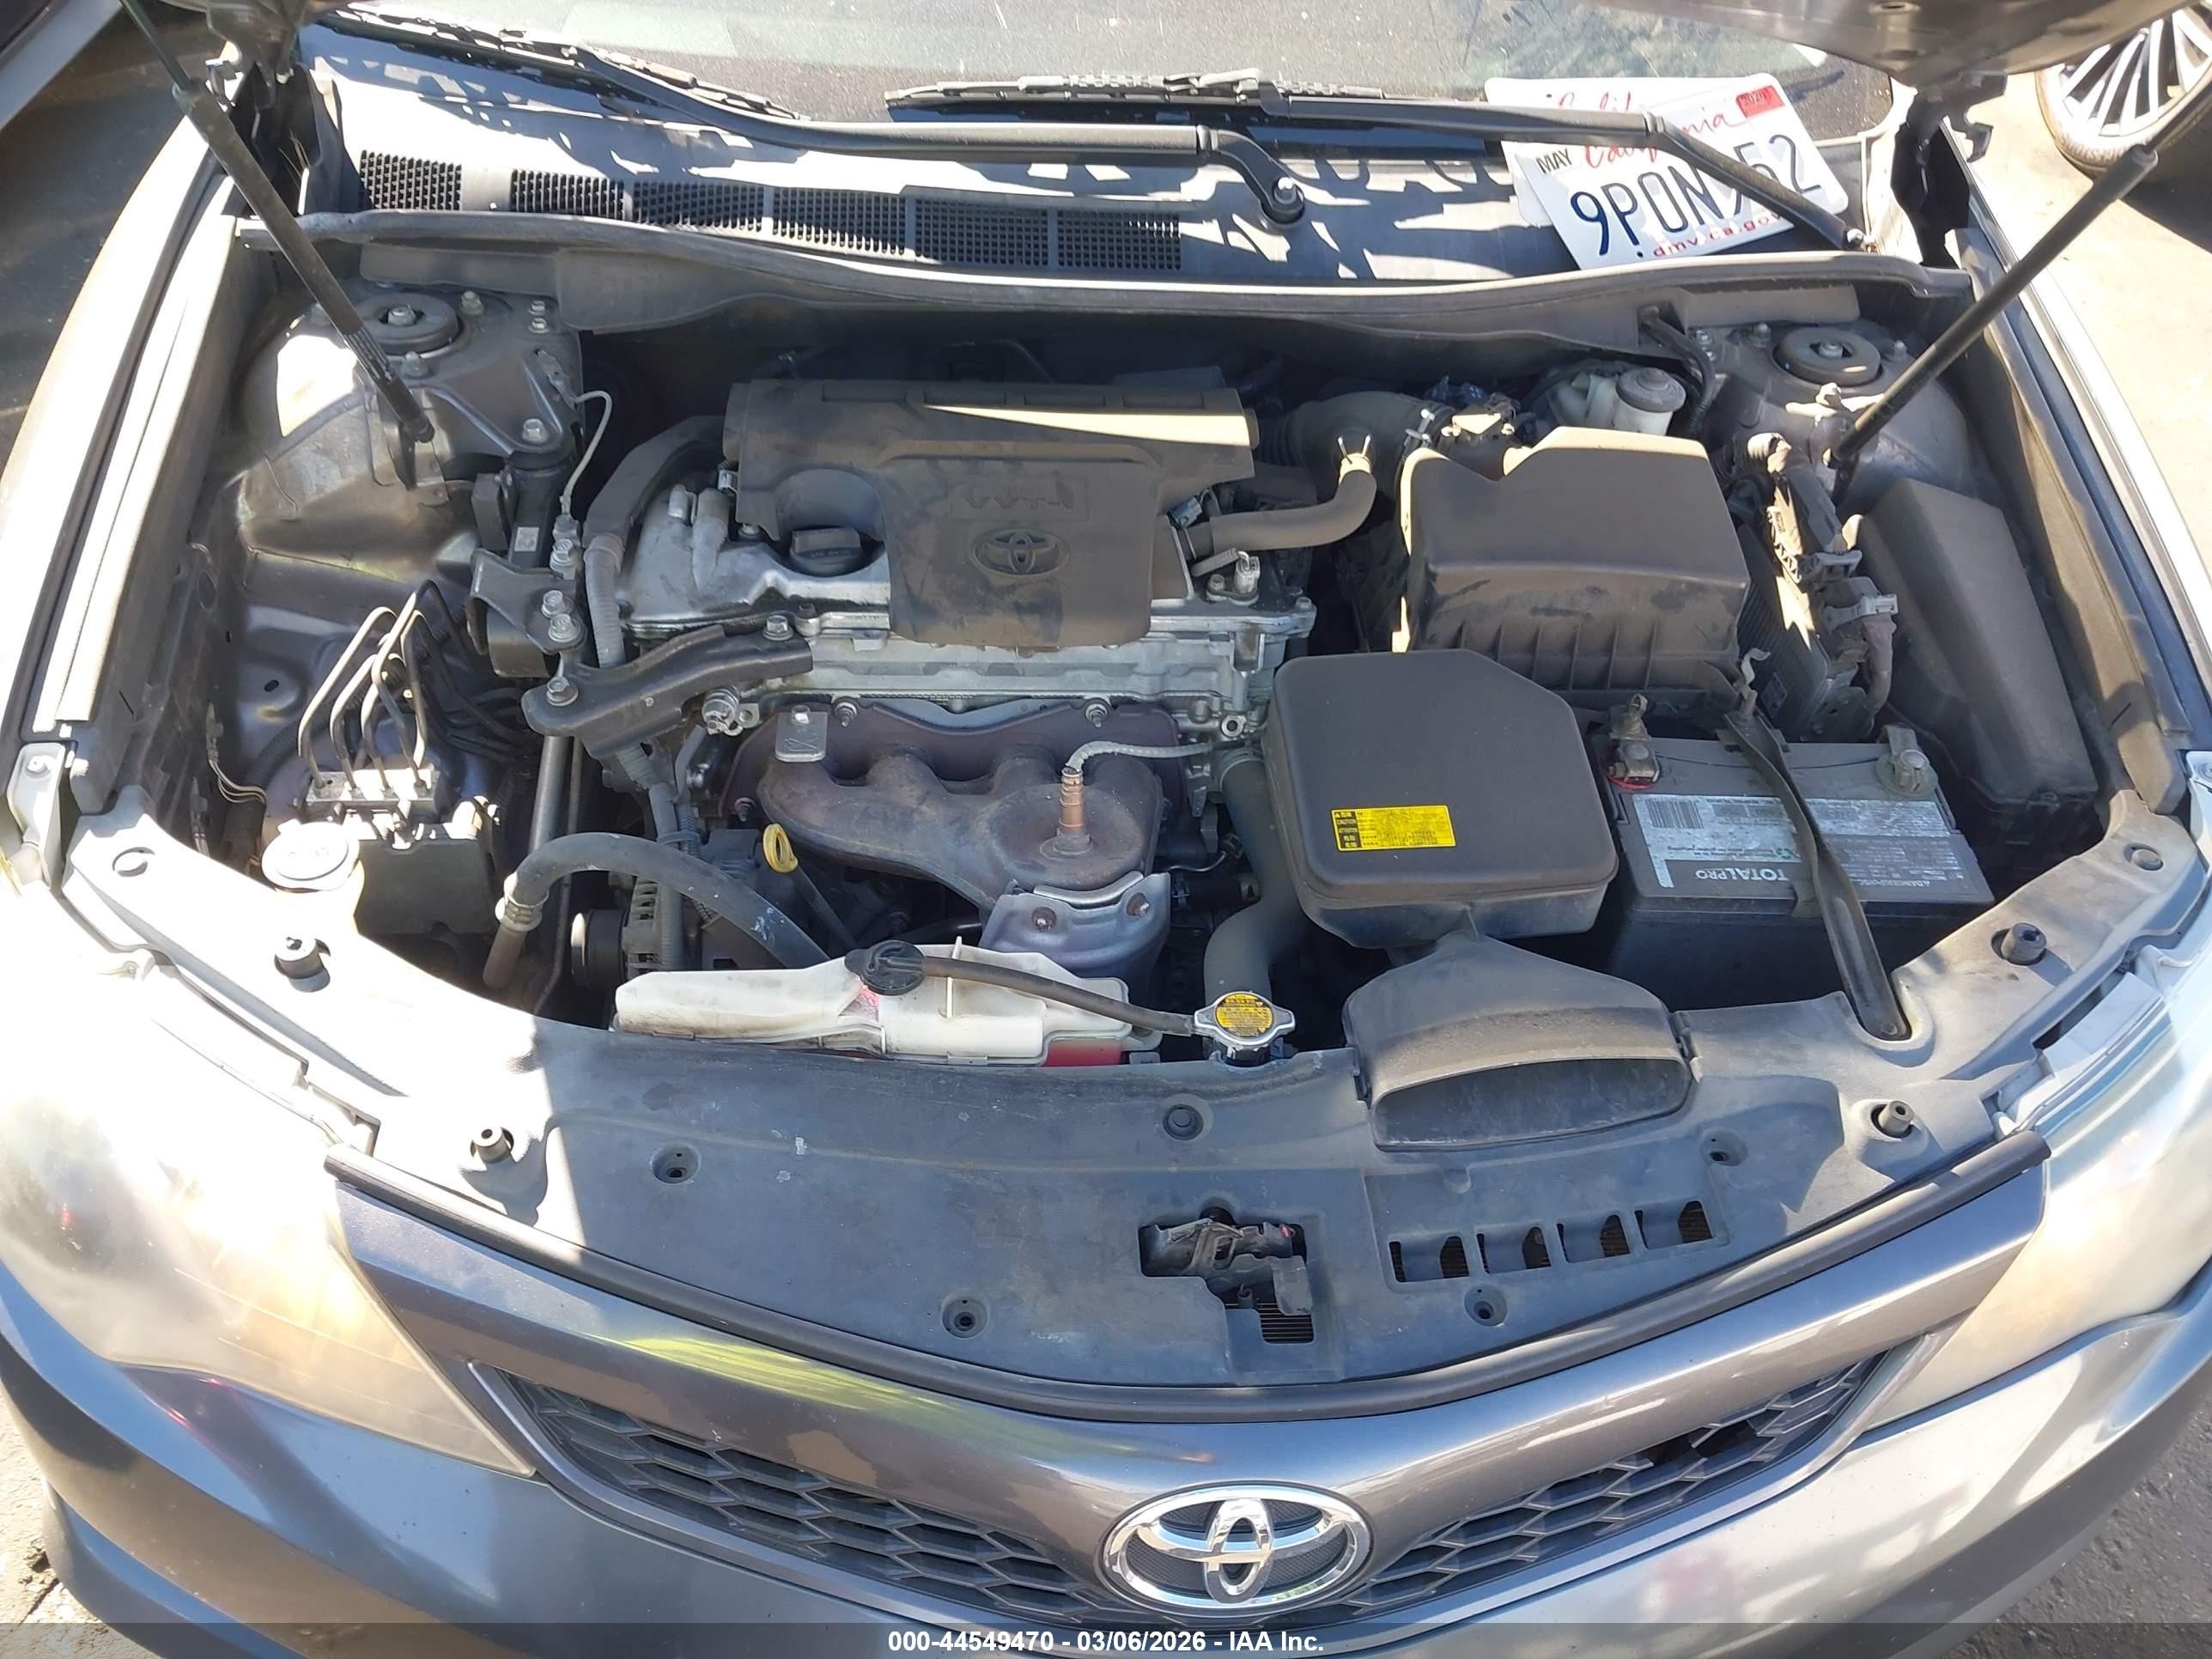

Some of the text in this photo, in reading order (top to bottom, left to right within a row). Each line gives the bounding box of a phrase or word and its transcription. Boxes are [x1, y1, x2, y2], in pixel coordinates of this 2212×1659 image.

[1535, 148, 1572, 173] MAY
[1570, 134, 1821, 256] 9PON52
[1695, 866, 1790, 882] TOTALPRO
